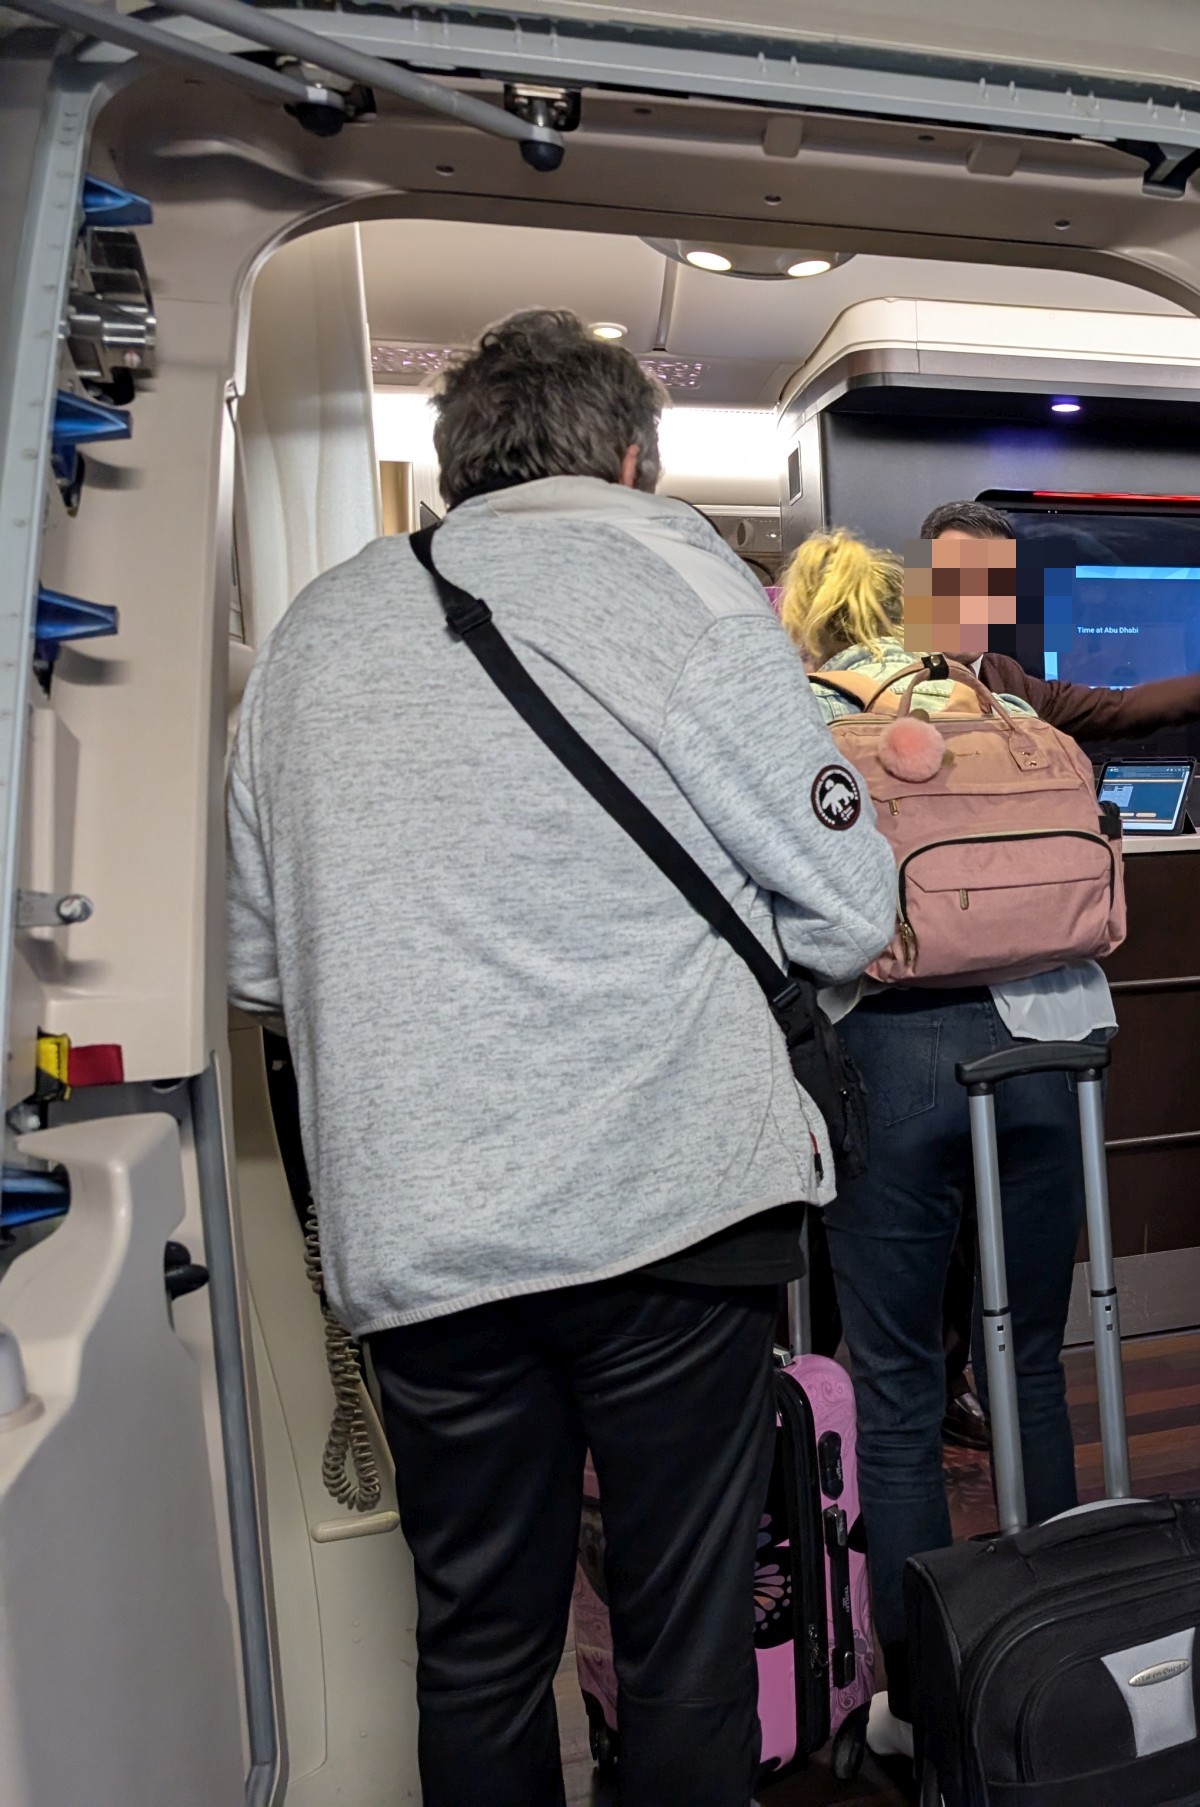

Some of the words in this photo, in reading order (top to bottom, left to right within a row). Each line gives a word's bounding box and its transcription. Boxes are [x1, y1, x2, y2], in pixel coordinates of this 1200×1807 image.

[1077, 626, 1095, 634] Time
[1104, 626, 1118, 634] Abu
[1119, 626, 1139, 634] Dhabi
